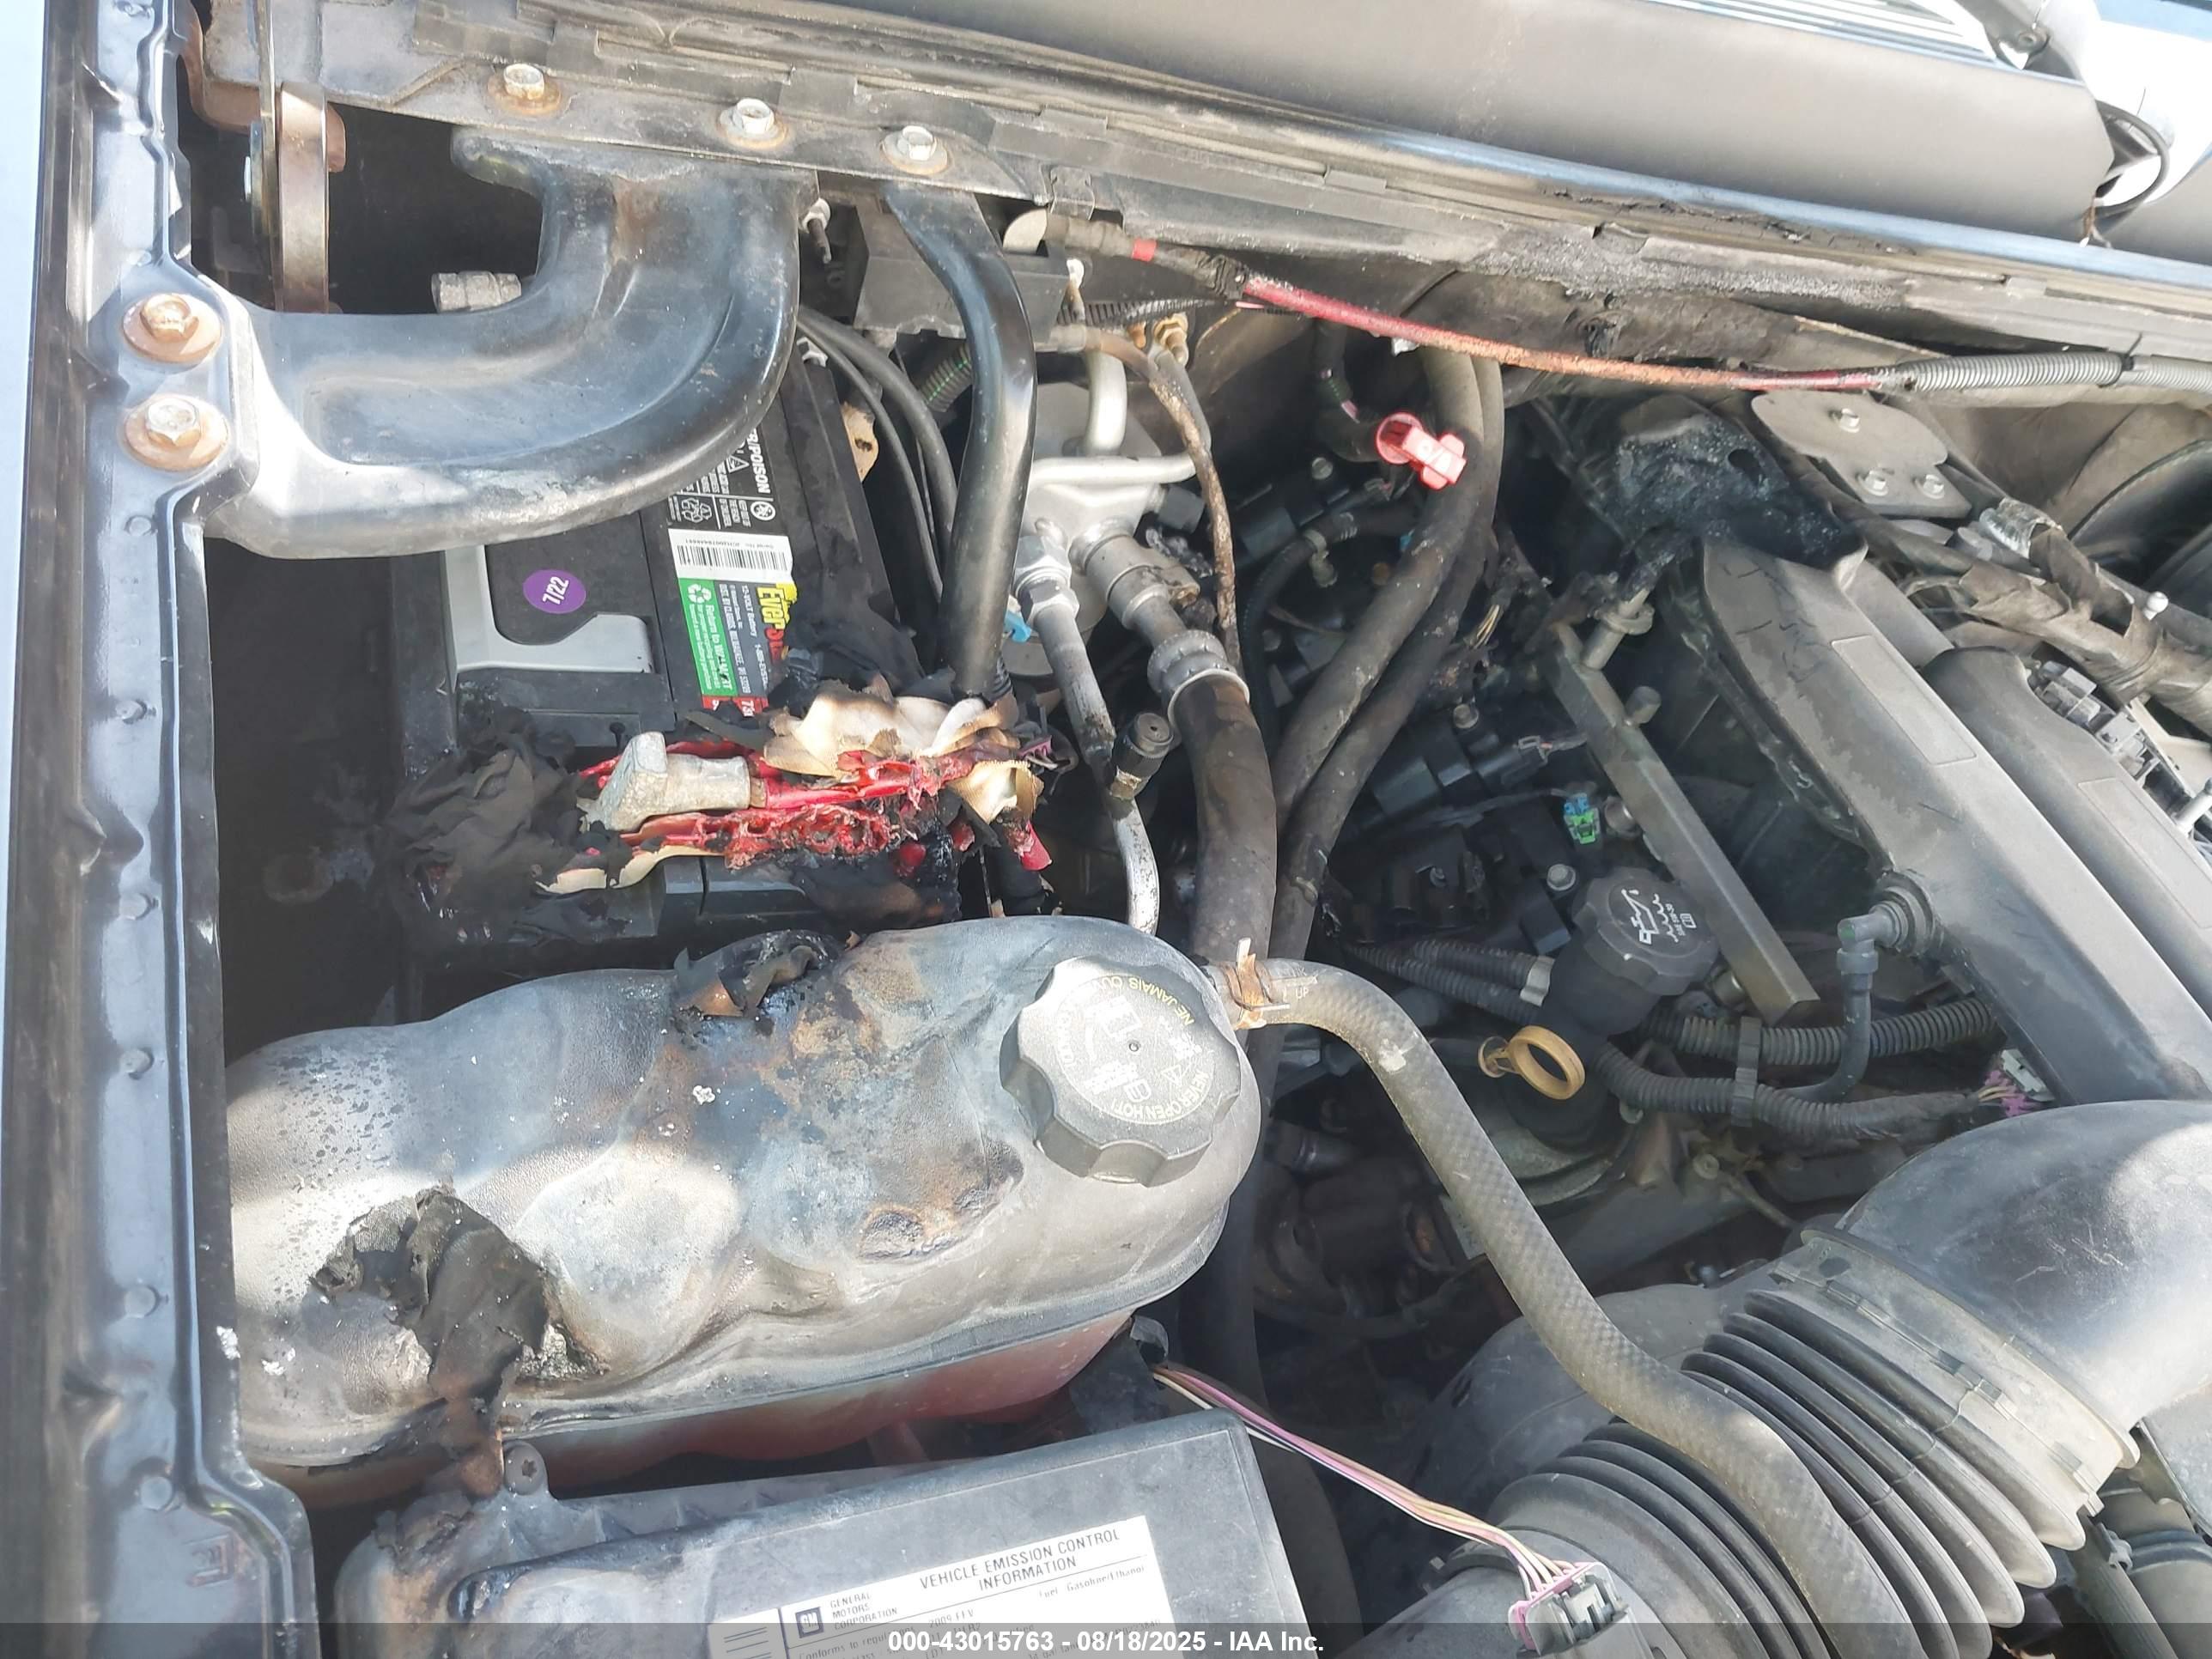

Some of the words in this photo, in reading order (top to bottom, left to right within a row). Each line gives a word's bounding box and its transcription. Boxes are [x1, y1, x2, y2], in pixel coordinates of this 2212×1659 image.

[543, 576, 569, 605] 7/22
[705, 605, 717, 634] Return
[712, 634, 720, 643] to
[1128, 977, 1177, 1006] JAMAIS
[1174, 1008, 1194, 1026] NE
[1180, 1069, 1211, 1107] NEVER
[1145, 1101, 1182, 1120] OPEN
[919, 1564, 979, 1589] VEHICLE
[984, 1545, 1054, 1573] EMISSION
[1057, 1528, 1121, 1554] CONTROL
[979, 1555, 1078, 1591] INFORMATION
[830, 1593, 871, 1608] GENERAL
[832, 1603, 871, 1620] MOTORS
[834, 1607, 898, 1631] CORPORATION
